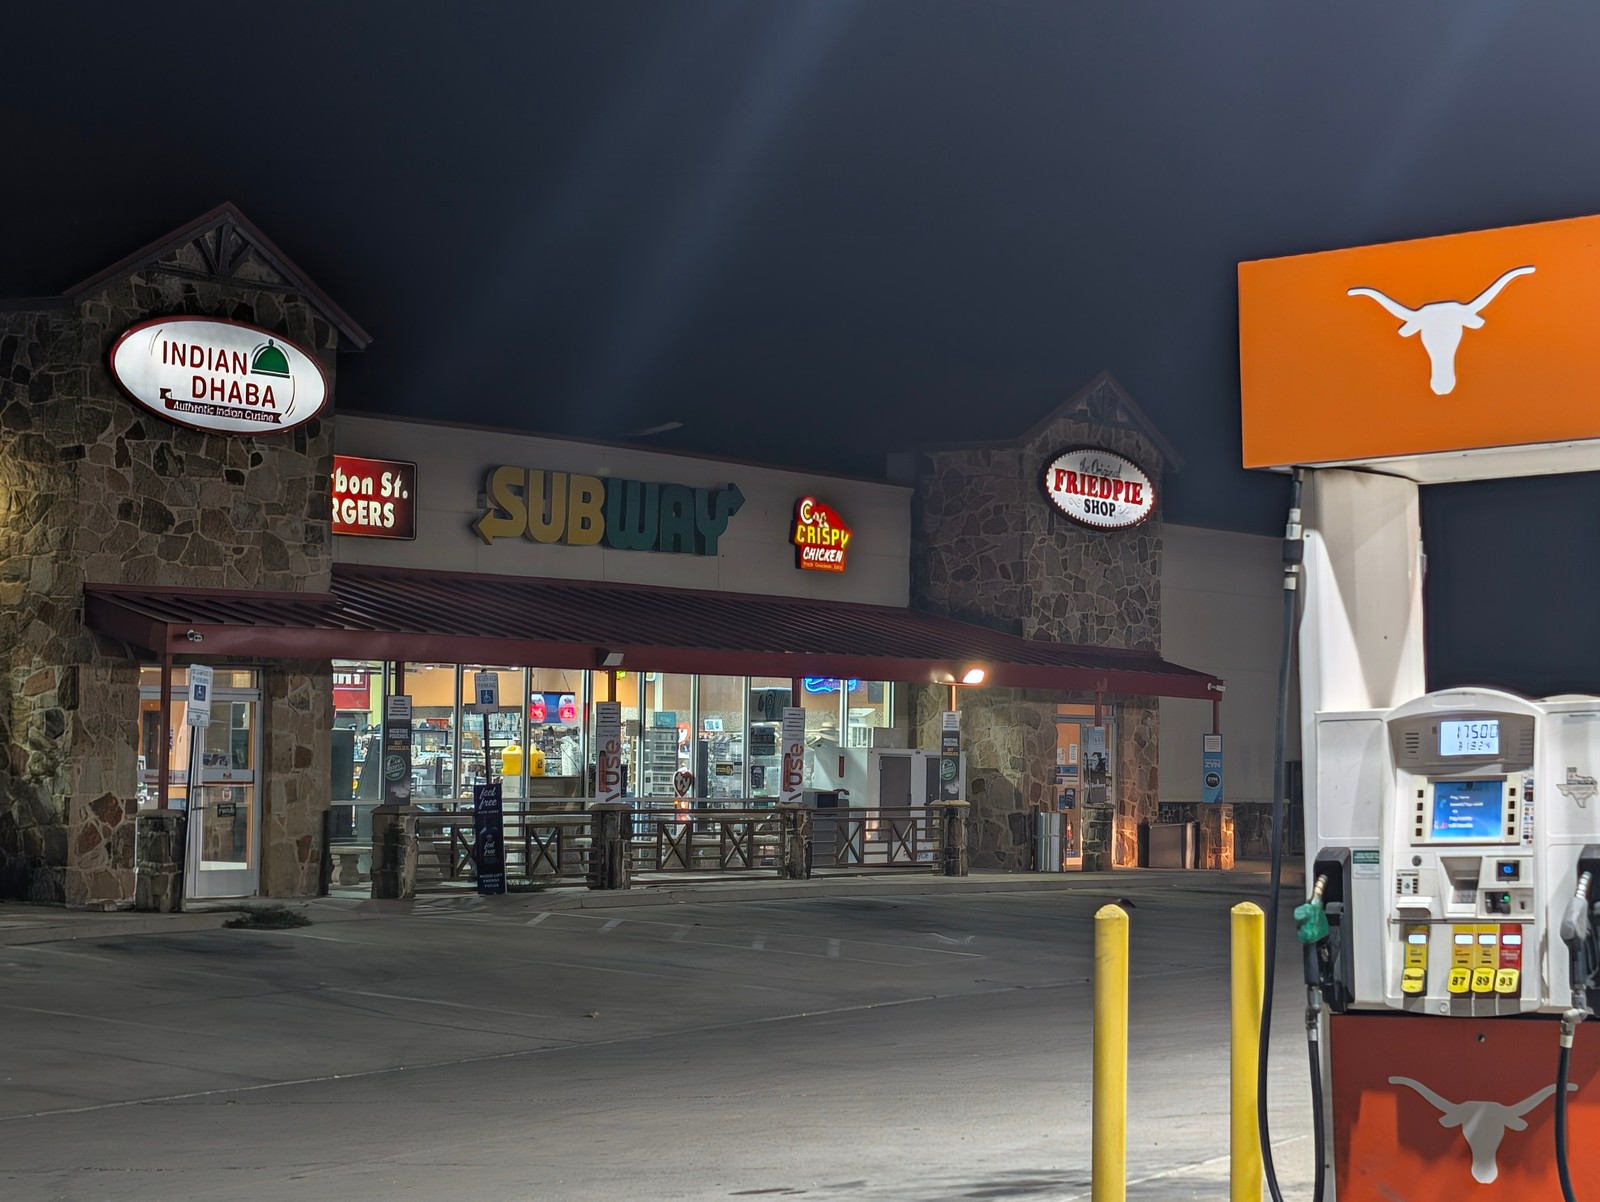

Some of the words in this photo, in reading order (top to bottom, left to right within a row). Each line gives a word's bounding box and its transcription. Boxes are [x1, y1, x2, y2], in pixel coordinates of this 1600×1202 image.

[162, 340, 248, 376] INDIAN
[191, 375, 276, 409] DHABA
[216, 406, 243, 419] Indian
[331, 466, 374, 495] bon
[380, 470, 408, 499] St.
[475, 465, 745, 557] SUBWAY
[1083, 498, 1116, 517] SHOP
[796, 524, 849, 549] CRISPY
[802, 546, 843, 563] CHICKEN
[480, 786, 496, 799] feel
[479, 798, 497, 810] free
[1452, 976, 1466, 986] 87
[1476, 976, 1490, 986] 89
[1499, 977, 1513, 987] 93
